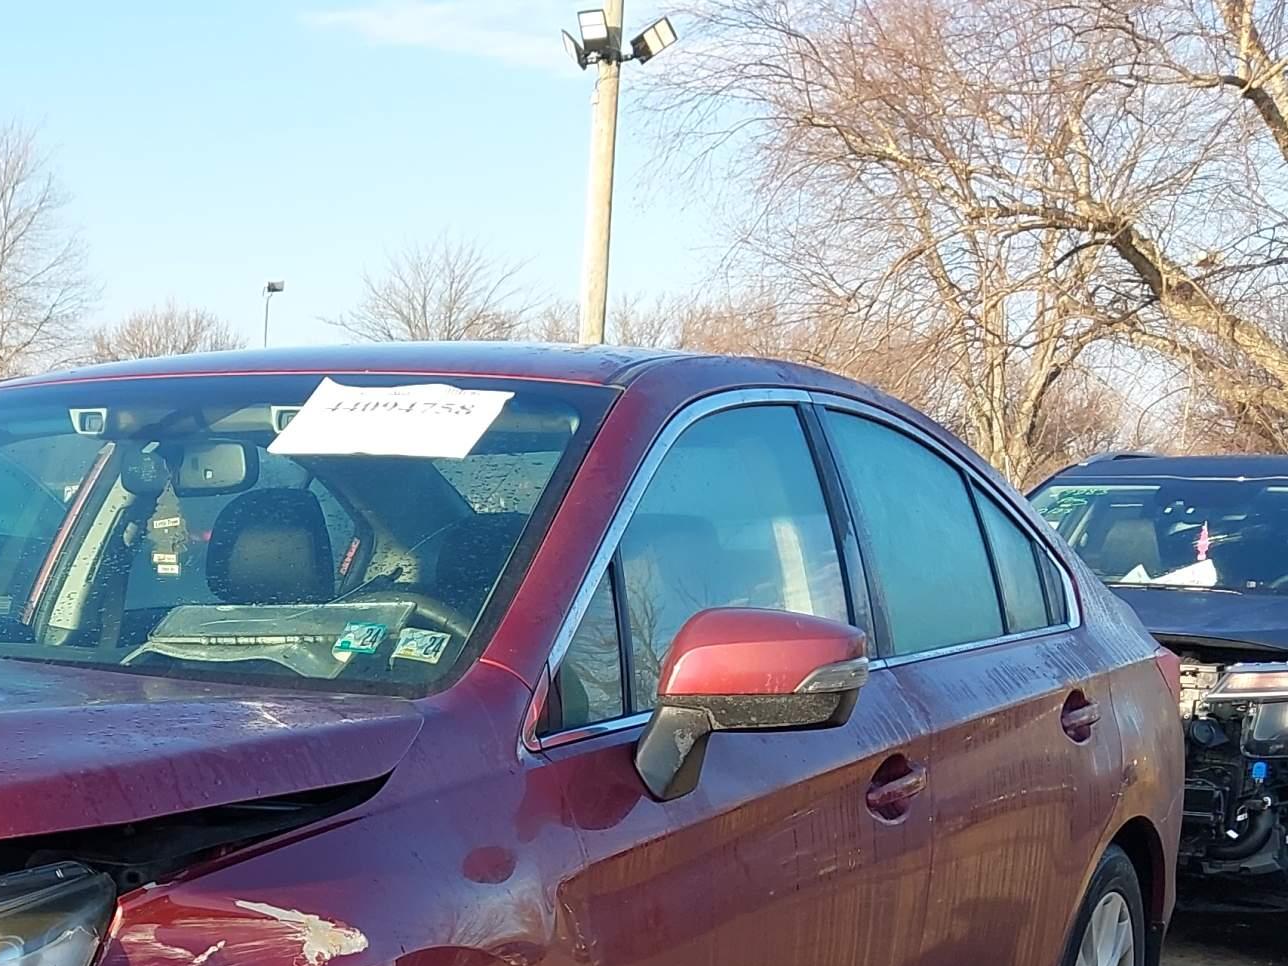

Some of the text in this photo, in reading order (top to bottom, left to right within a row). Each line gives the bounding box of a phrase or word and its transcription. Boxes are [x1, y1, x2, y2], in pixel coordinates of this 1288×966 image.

[325, 401, 476, 415] 44094758
[360, 628, 382, 647] 24
[422, 635, 445, 657] 24
